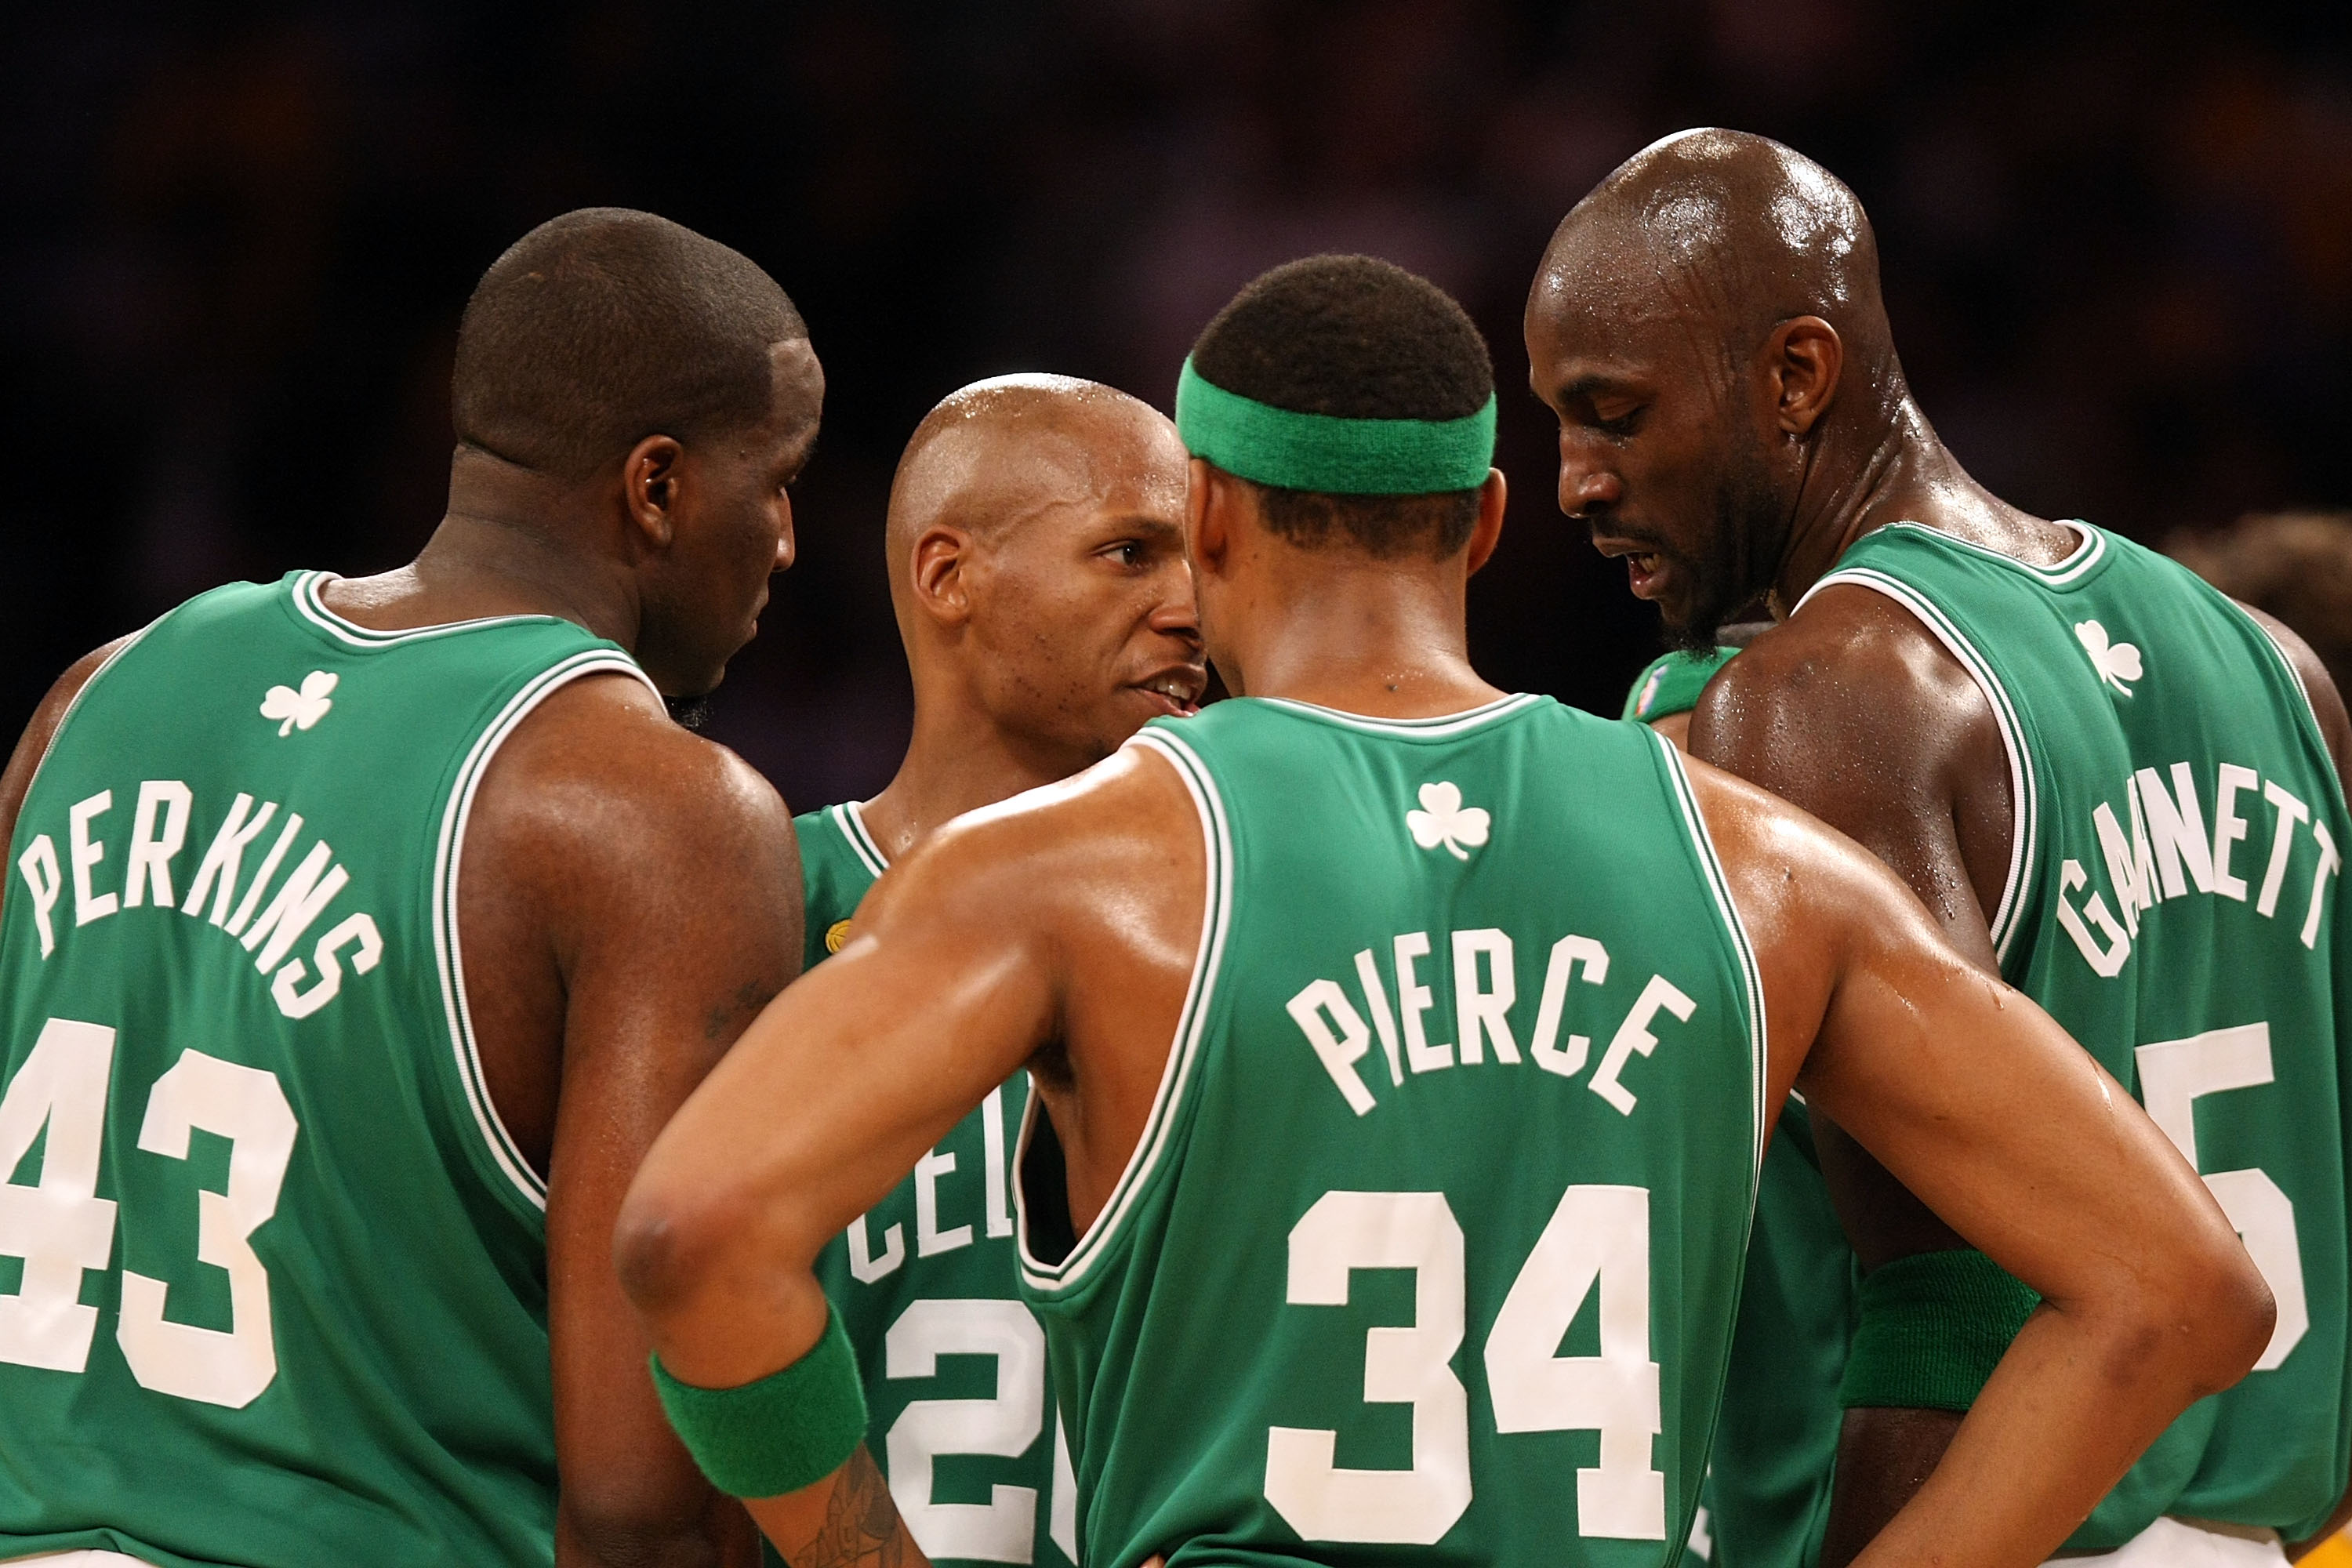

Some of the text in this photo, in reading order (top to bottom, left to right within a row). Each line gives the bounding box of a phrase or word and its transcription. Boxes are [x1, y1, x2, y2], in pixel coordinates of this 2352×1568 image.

[17, 780, 384, 1019] PERKINS
[2056, 760, 2343, 978] GARNETT
[1285, 927, 1697, 1117] PIERCE
[0, 1017, 299, 1410] 43
[2134, 1021, 2310, 1371] 5
[885, 1298, 1079, 1567] 2
[1263, 1185, 1667, 1546] 34
